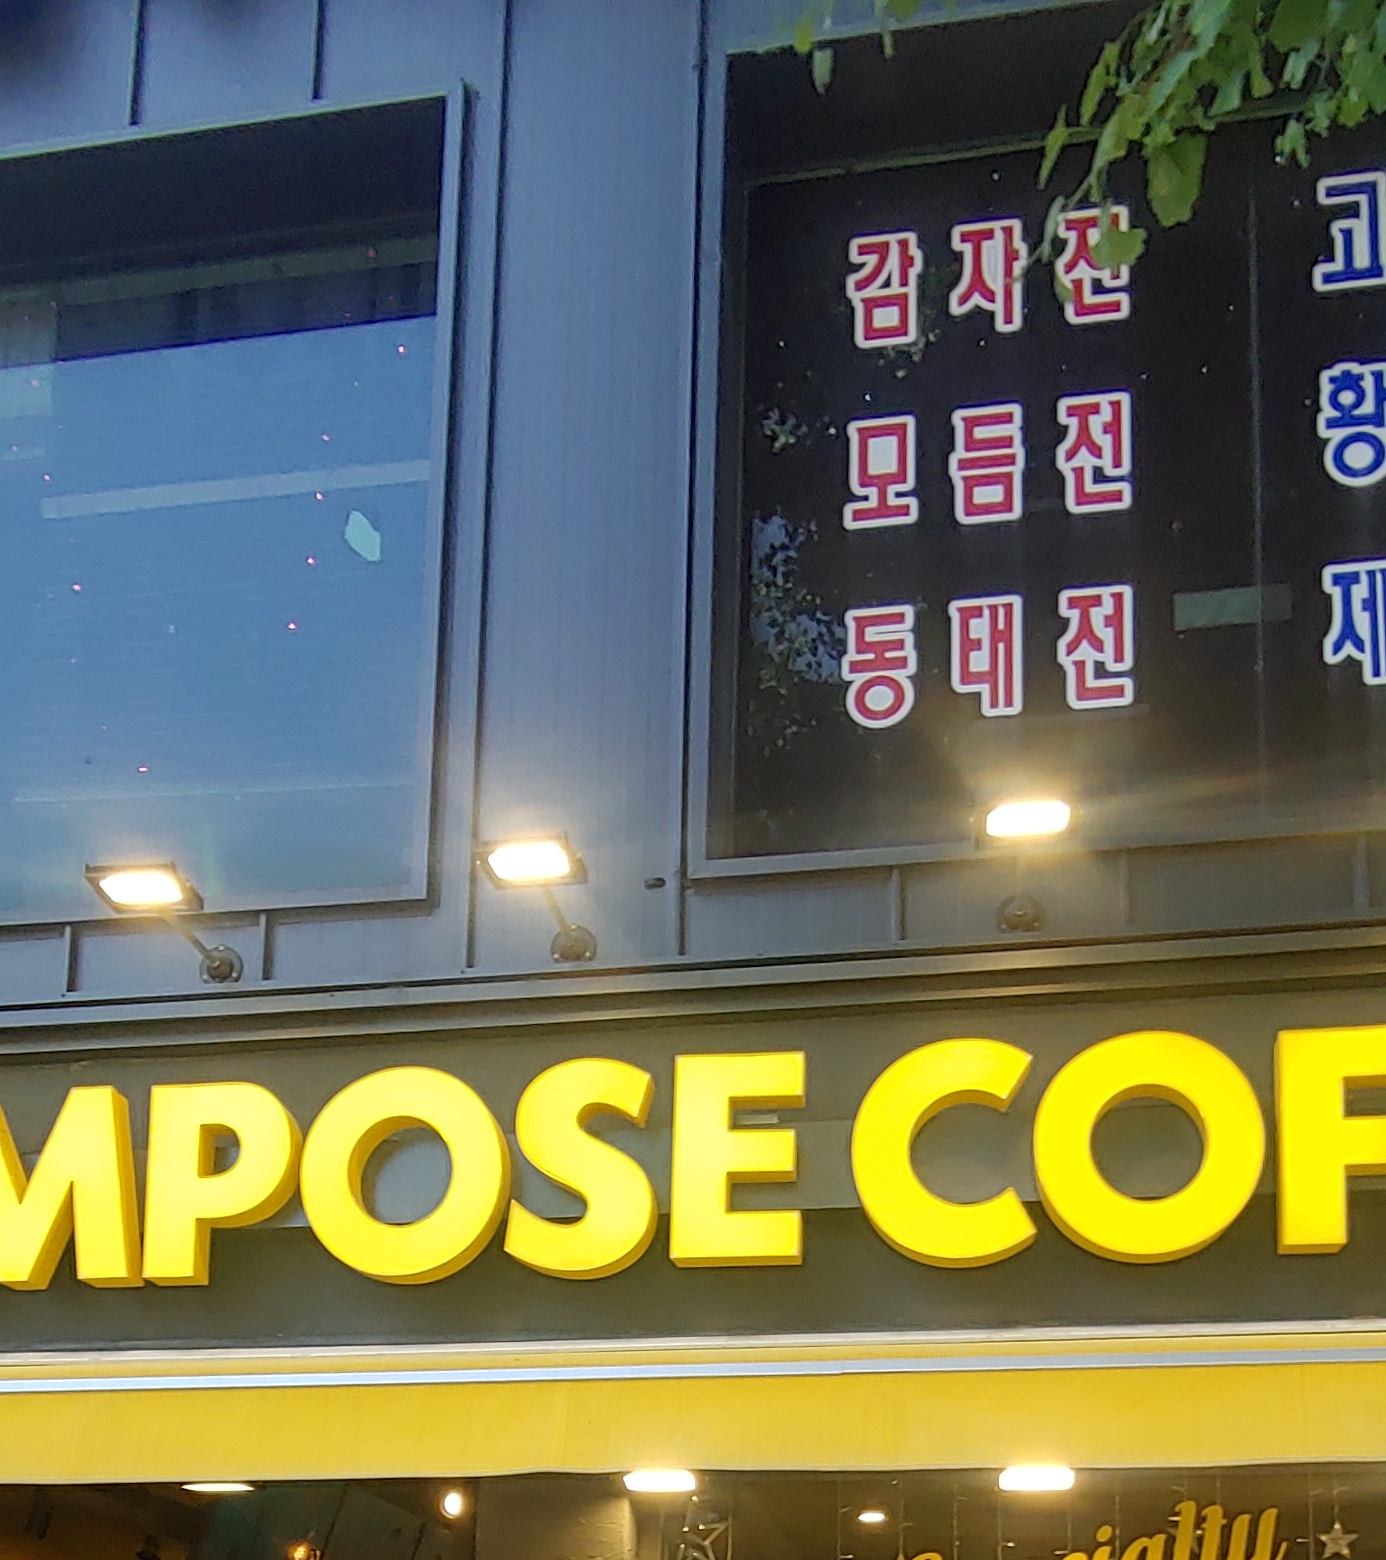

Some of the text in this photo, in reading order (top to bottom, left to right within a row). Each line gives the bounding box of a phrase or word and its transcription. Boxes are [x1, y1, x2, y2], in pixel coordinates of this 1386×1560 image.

[846, 205, 1132, 348] 감자전
[842, 389, 1133, 531] 모듬전
[840, 582, 1136, 729] 동태전
